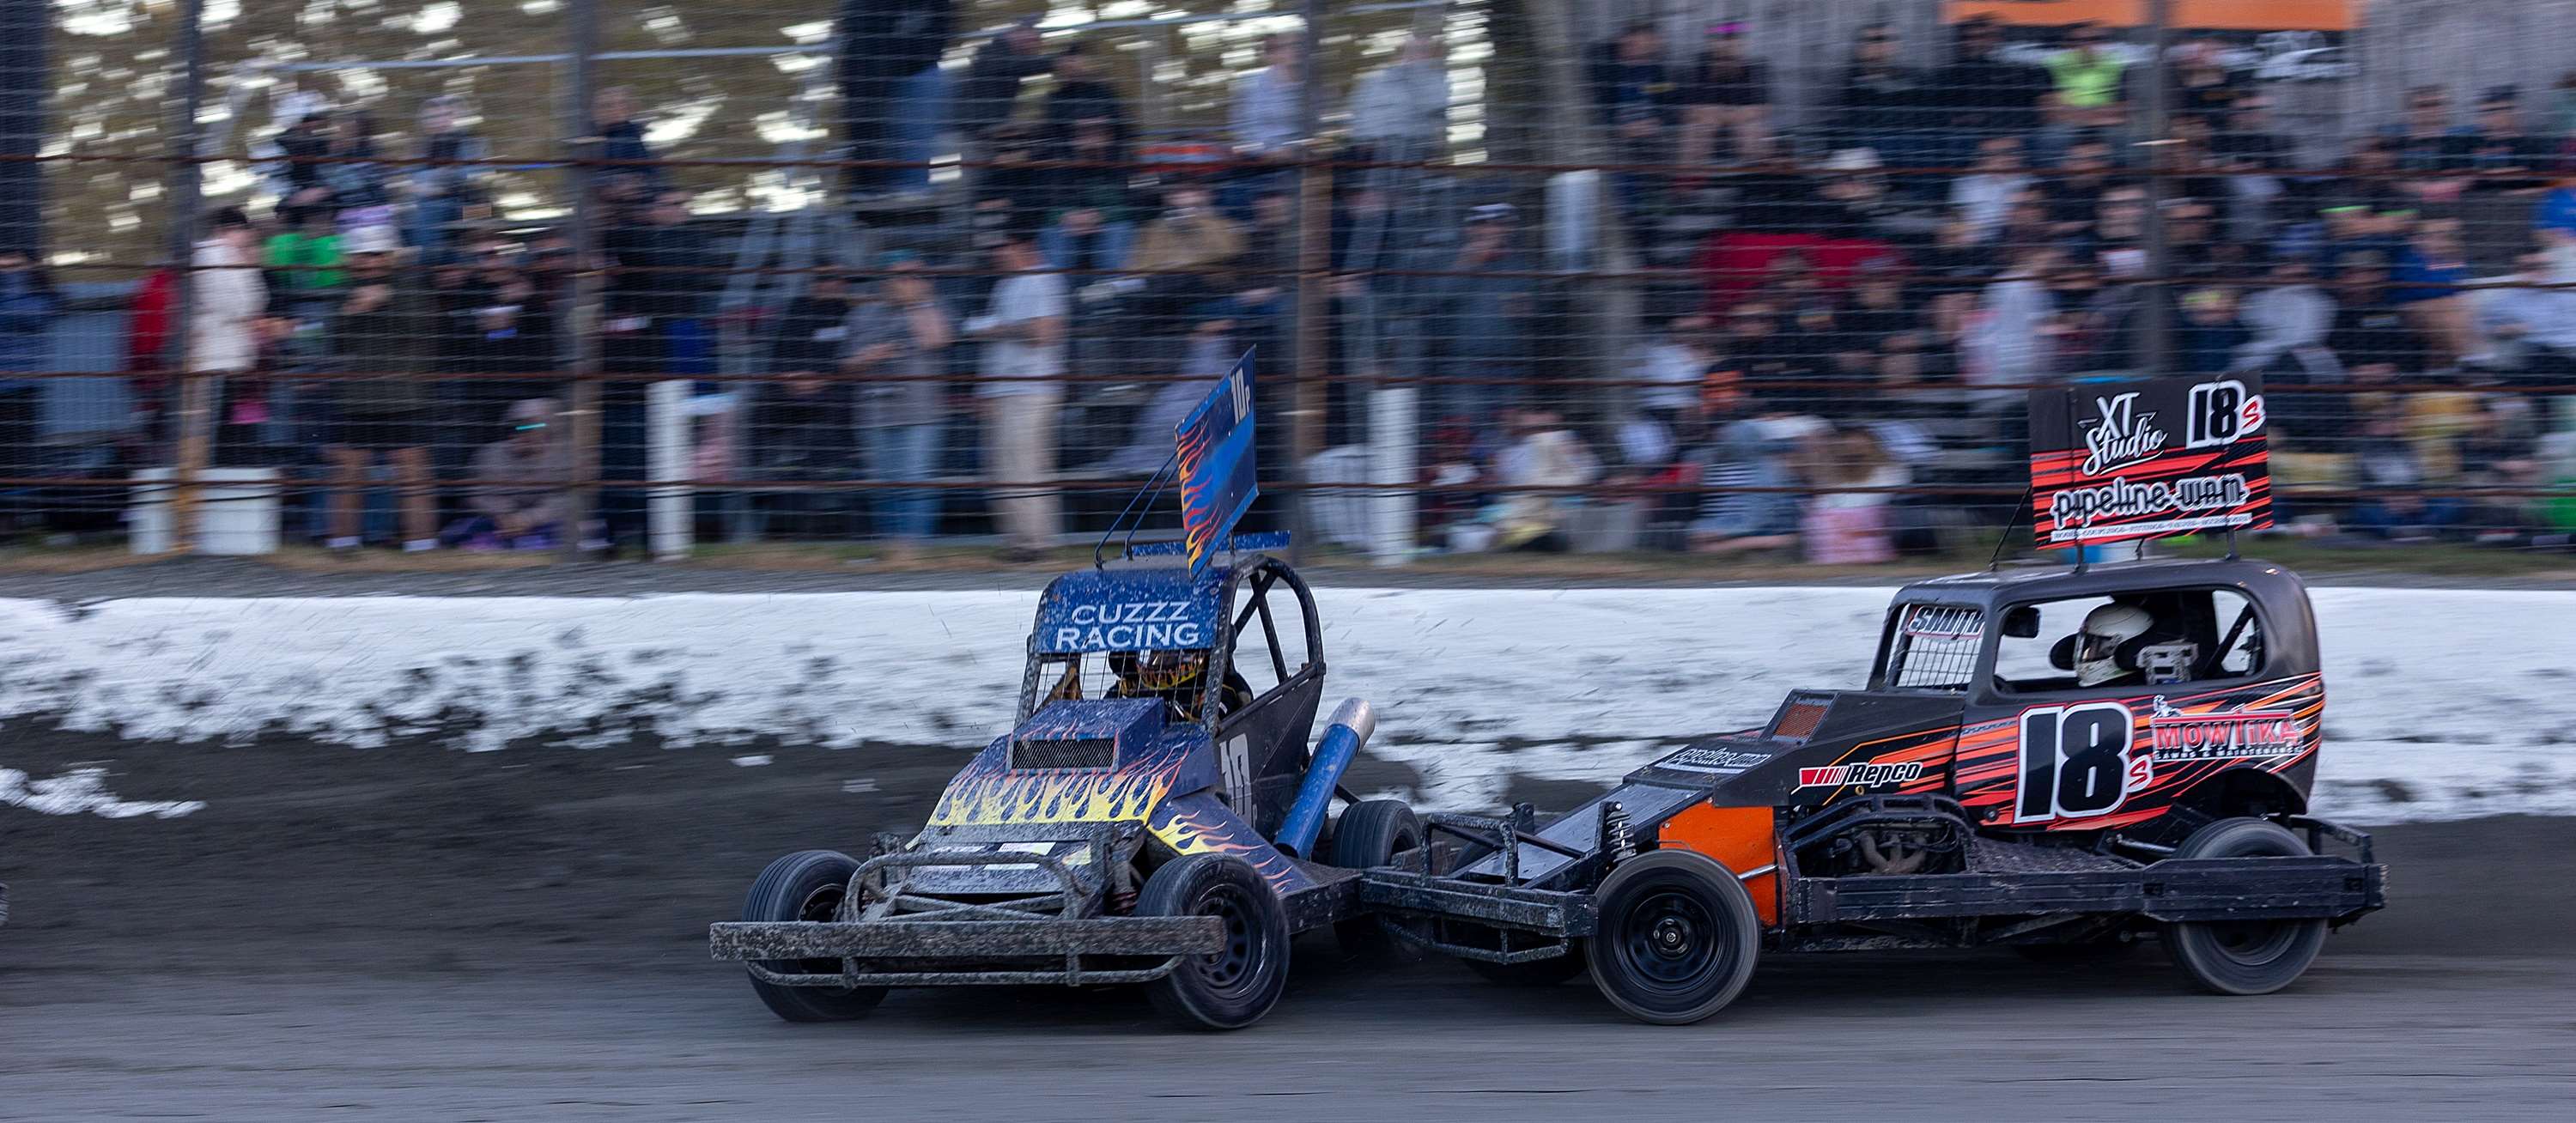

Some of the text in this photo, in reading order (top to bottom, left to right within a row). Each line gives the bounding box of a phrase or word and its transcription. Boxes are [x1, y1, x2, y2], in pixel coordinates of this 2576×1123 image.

[2095, 392, 2141, 438] XT
[2082, 416, 2168, 477] Studio
[1072, 600, 1192, 626] CUZZZ
[1909, 605, 1985, 634] SMITH
[1055, 622, 1200, 650] RACING
[1845, 762, 1923, 789] Repco
